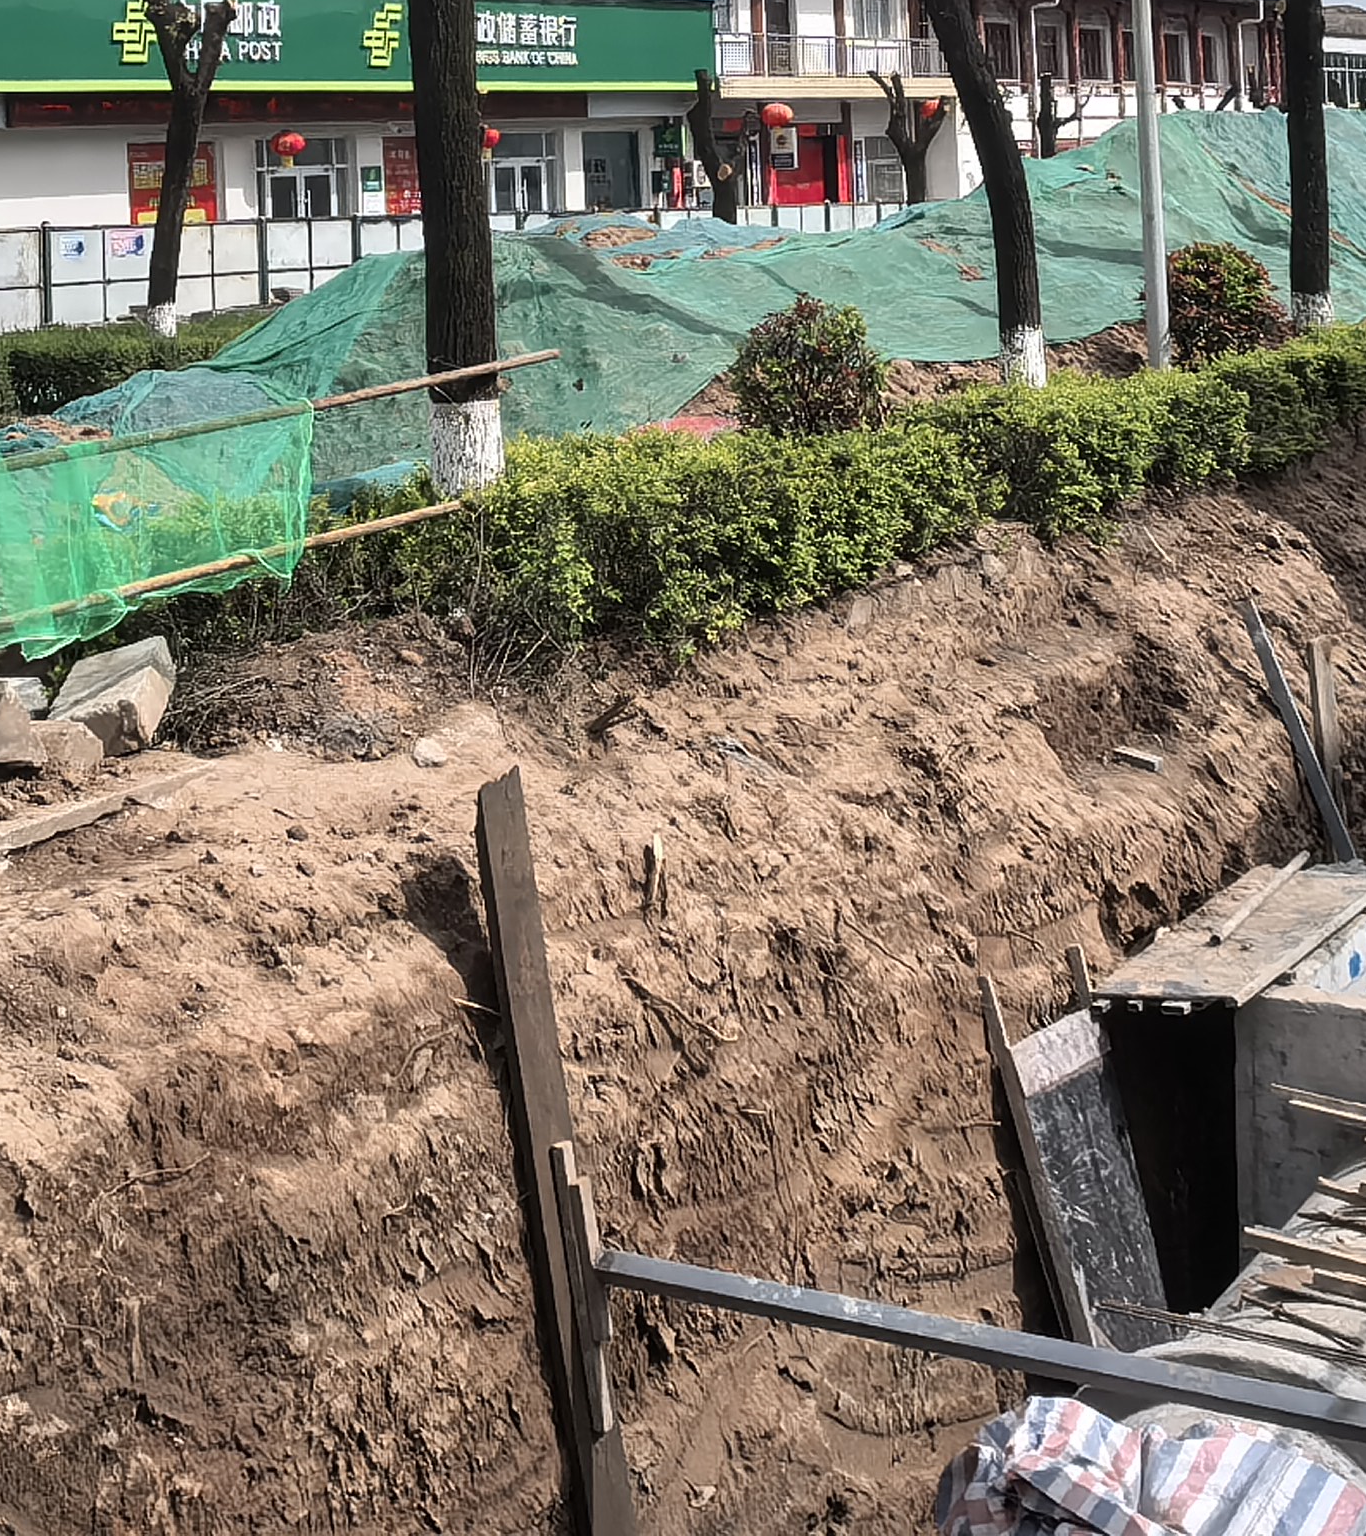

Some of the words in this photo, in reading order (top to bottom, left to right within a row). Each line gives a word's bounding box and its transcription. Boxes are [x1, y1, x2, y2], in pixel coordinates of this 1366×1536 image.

[476, 10, 577, 47] 政储蓄银行
[238, 40, 283, 62] POST
